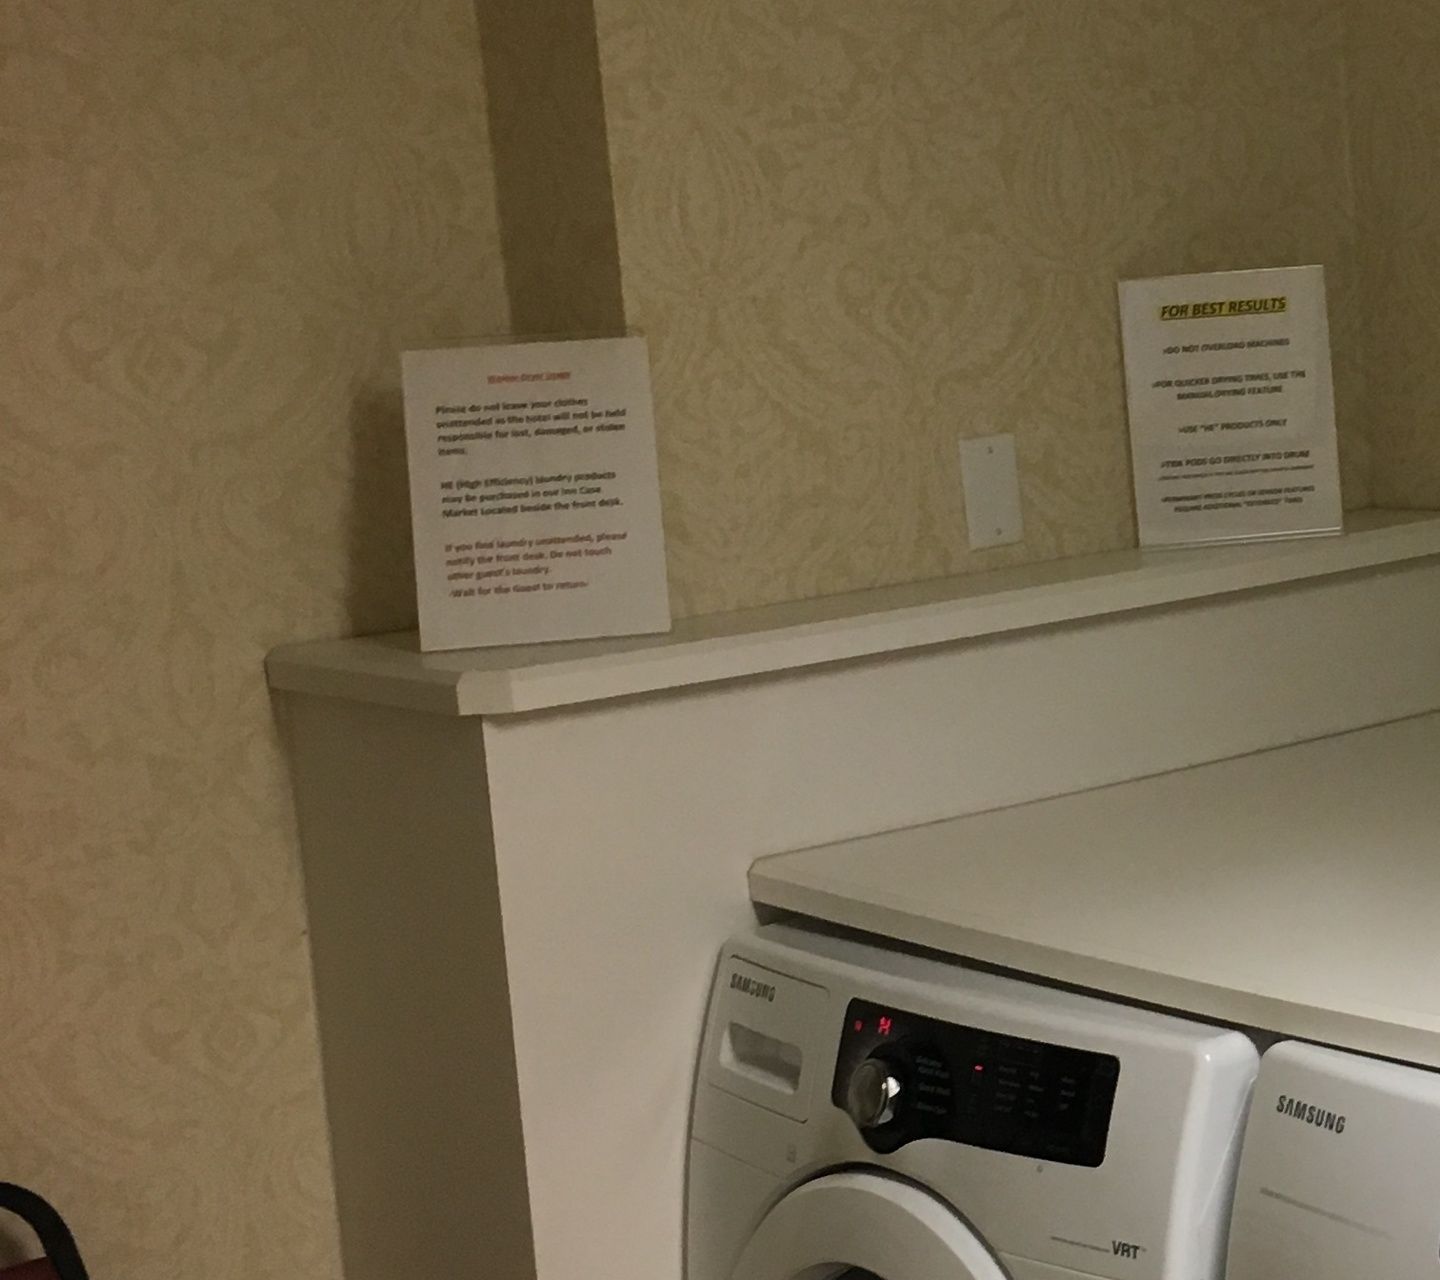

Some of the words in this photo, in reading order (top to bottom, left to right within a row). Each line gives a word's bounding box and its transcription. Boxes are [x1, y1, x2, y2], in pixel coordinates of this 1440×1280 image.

[1160, 303, 1190, 320] FOR
[1192, 300, 1226, 318] BEST
[1227, 296, 1287, 315] RESULTS
[730, 972, 776, 1003] SAMSUNG
[1275, 1094, 1346, 1135] SAMSUNG
